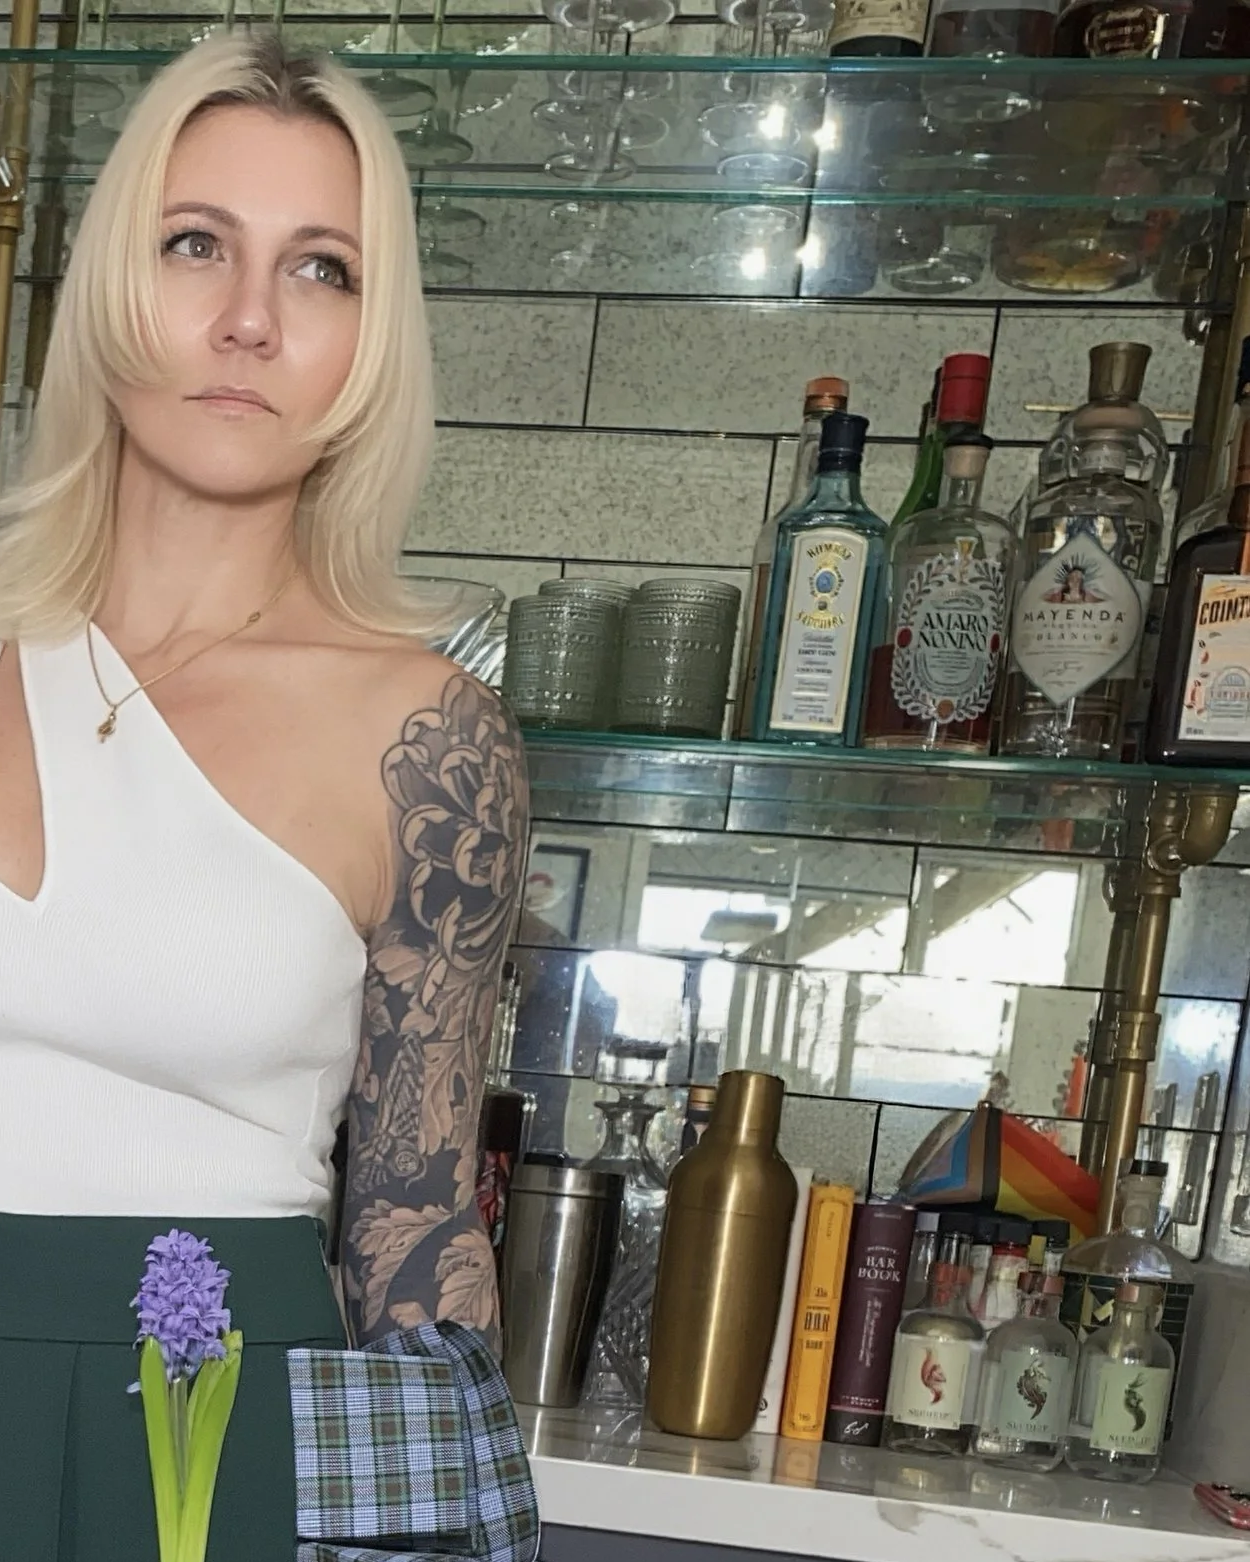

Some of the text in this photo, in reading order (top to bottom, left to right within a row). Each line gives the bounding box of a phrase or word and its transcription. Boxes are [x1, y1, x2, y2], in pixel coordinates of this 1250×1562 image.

[1023, 607, 1125, 622] MAYENDA
[921, 612, 989, 633] AMARO
[917, 630, 987, 652] NONINO
[866, 1255, 896, 1269] BAR
[857, 1267, 901, 1282] BOOK
